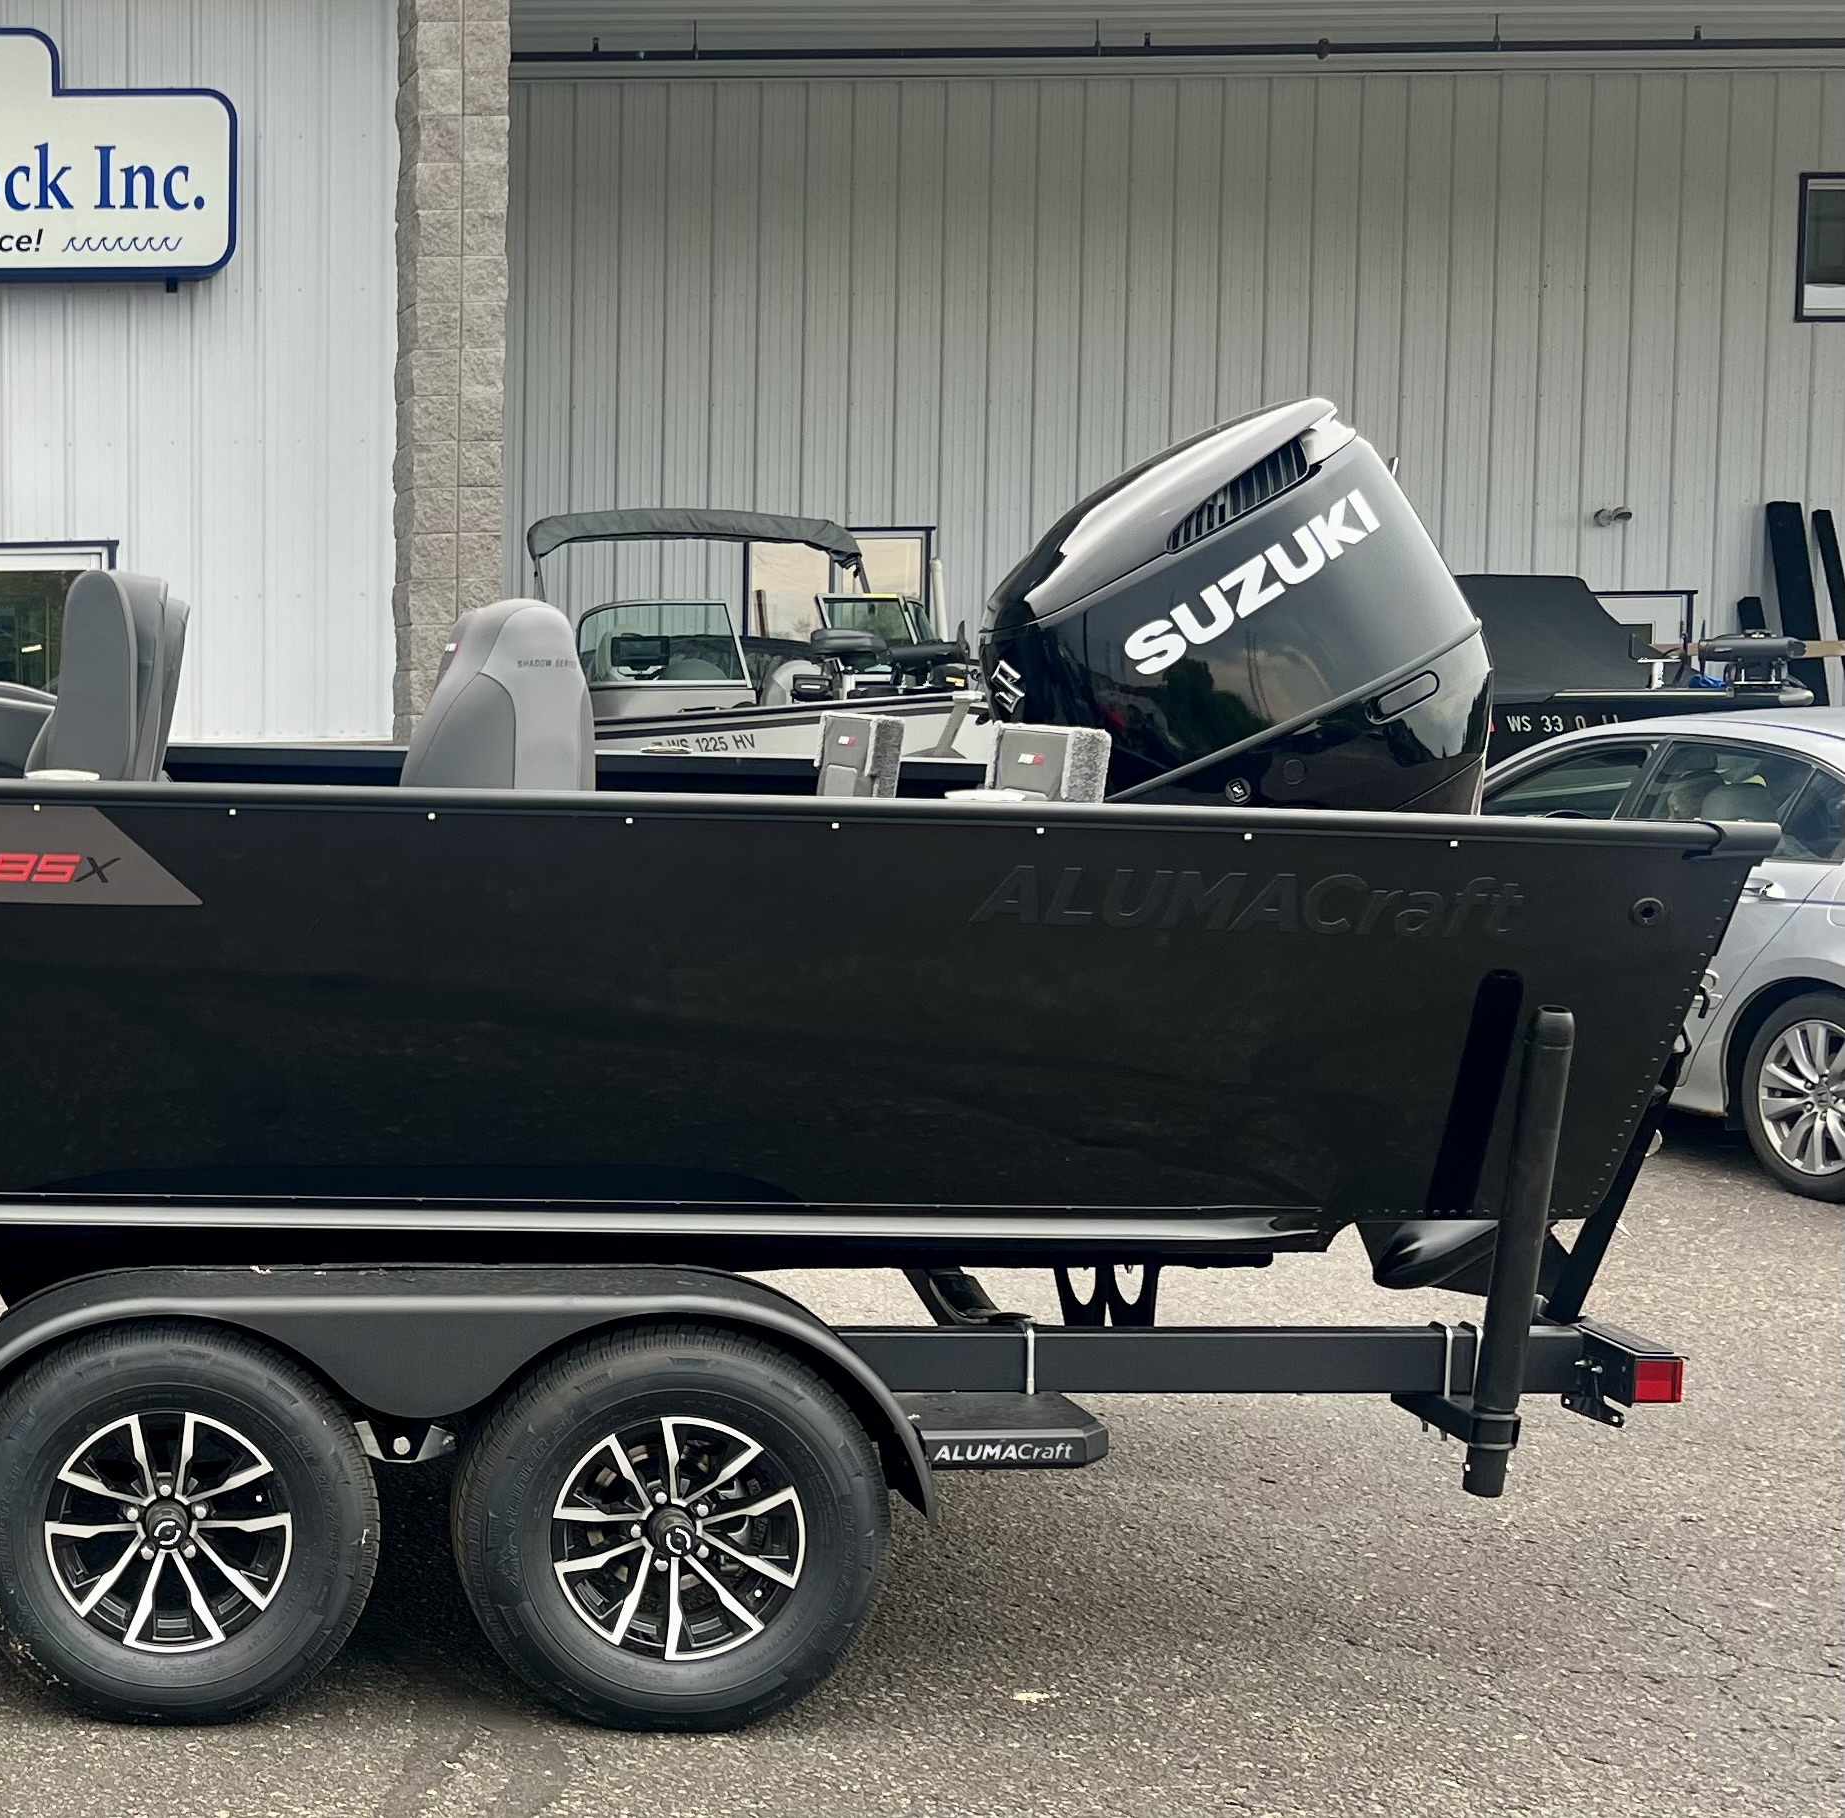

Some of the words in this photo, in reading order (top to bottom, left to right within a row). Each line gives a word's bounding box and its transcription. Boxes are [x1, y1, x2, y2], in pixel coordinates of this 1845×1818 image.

[94, 146, 206, 211] Inc.
[1124, 489, 1381, 675] SUZUKI
[695, 736, 729, 752] 1225
[732, 733, 756, 749] HV
[1506, 715, 1533, 732] WS
[967, 865, 1525, 938] ALUMACraft
[934, 1442, 1073, 1461] ALUMACraft
